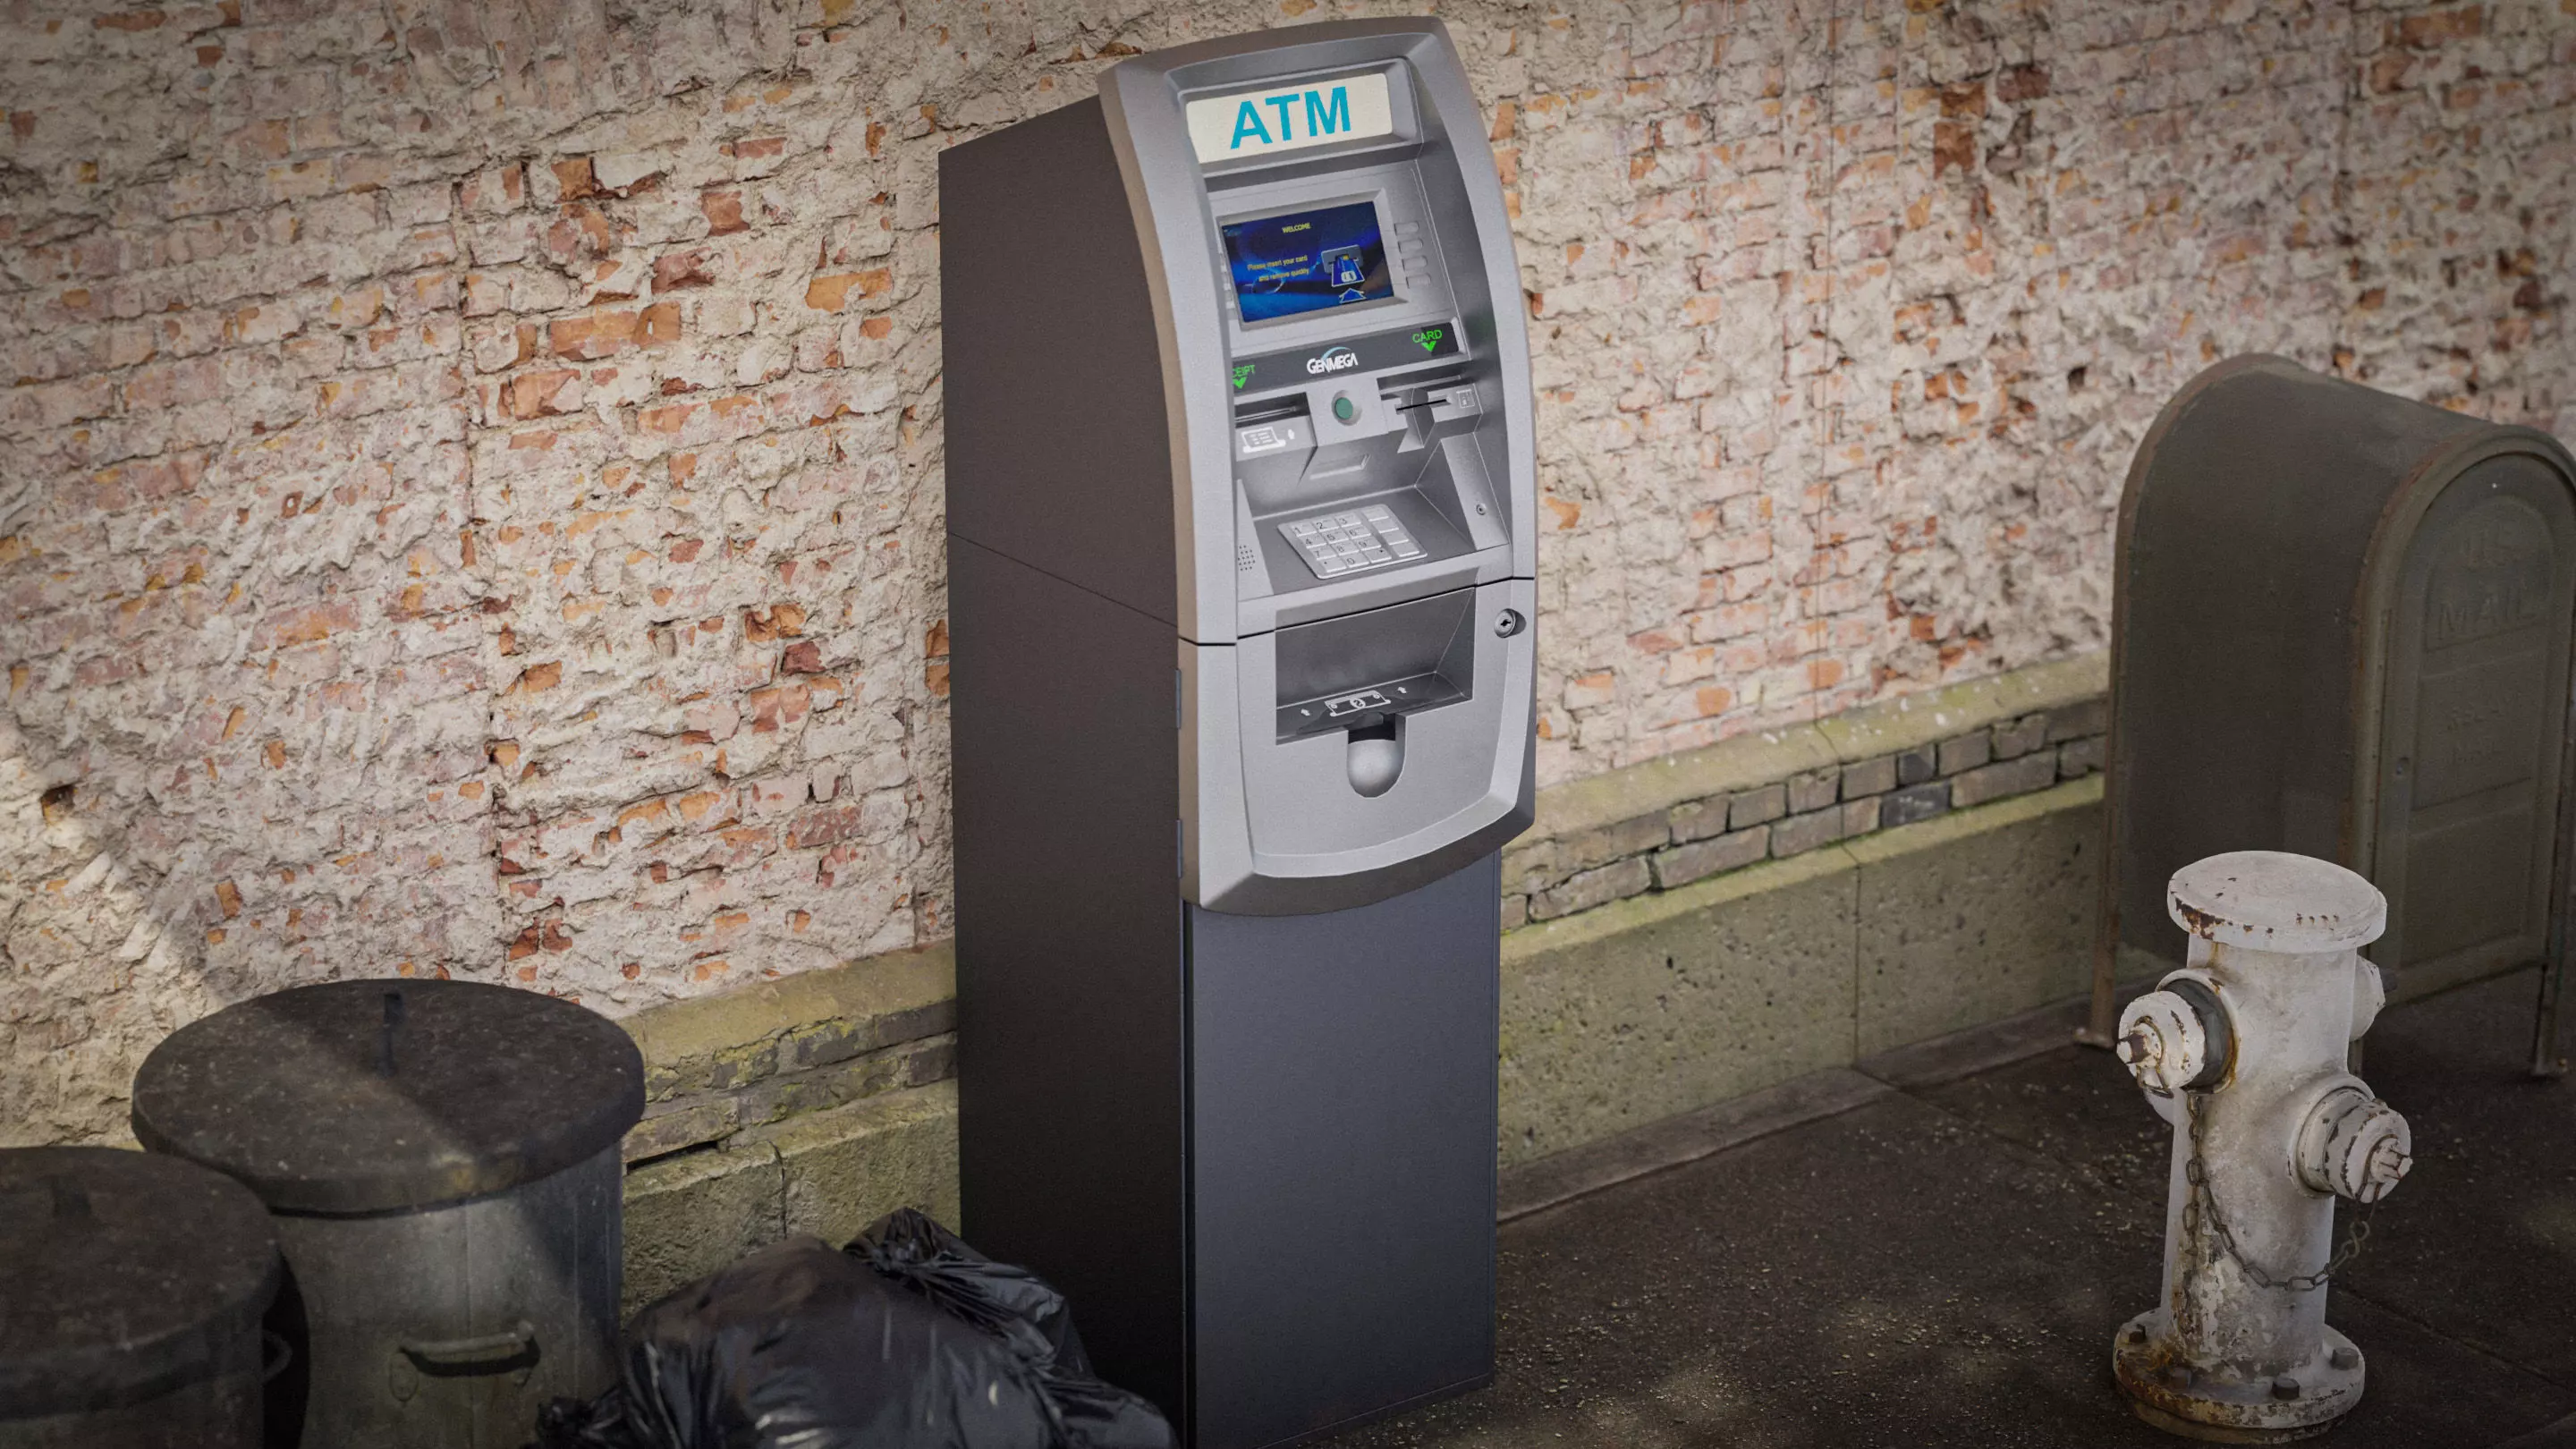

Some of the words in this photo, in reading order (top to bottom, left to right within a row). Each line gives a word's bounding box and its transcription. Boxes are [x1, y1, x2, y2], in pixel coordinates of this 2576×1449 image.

[1230, 86, 1352, 150] ATM
[1282, 223, 1311, 233] WELCOME
[1283, 258, 1295, 267] your
[1295, 255, 1309, 263] card
[1412, 329, 1443, 343] CARD
[1307, 352, 1359, 374] GENMEGA
[2437, 581, 2538, 641] MAIL
